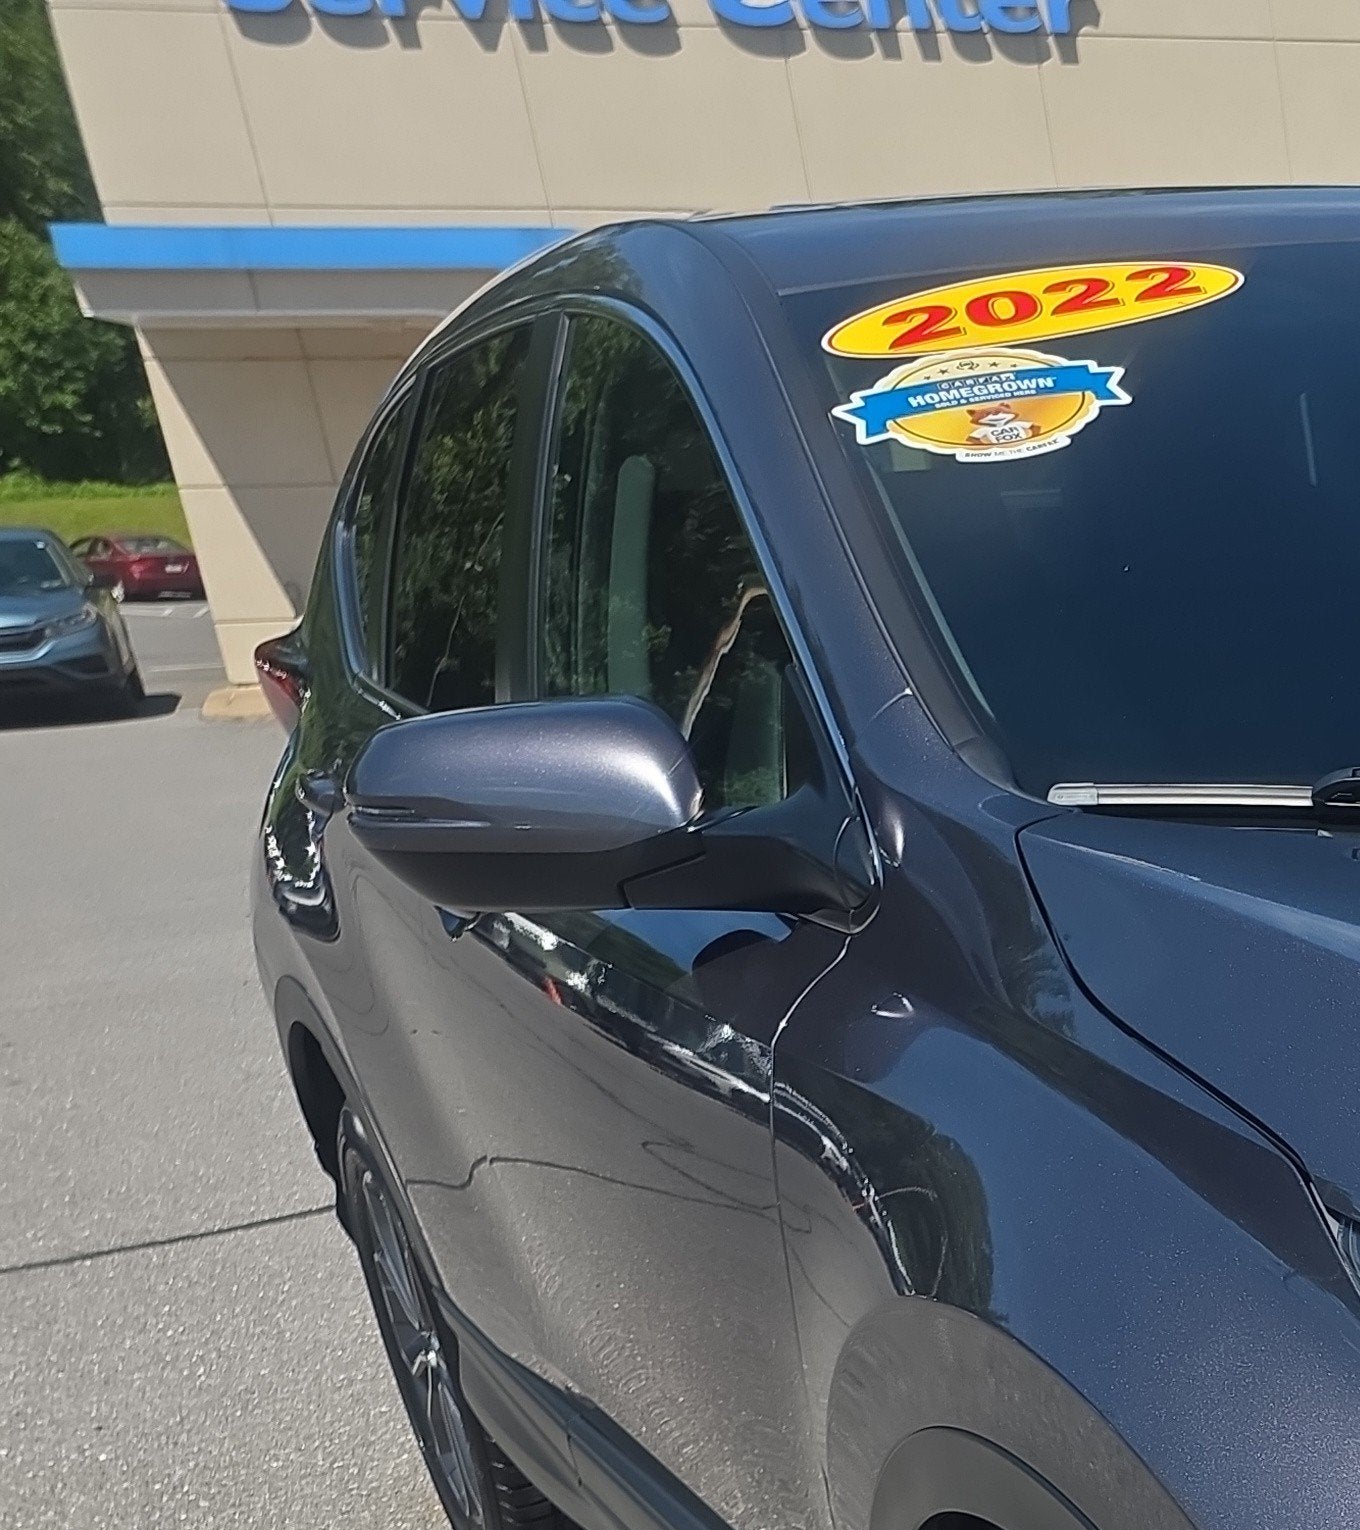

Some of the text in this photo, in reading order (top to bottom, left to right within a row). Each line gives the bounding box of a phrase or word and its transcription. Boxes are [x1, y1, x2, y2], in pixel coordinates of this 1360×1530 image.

[881, 266, 1207, 351] 2022
[908, 377, 1055, 408] HOMEGROWN
[934, 399, 959, 409] SOLD
[969, 393, 1012, 403] SERVICED
[990, 426, 1020, 437] CAR
[995, 432, 1022, 444] FOX
